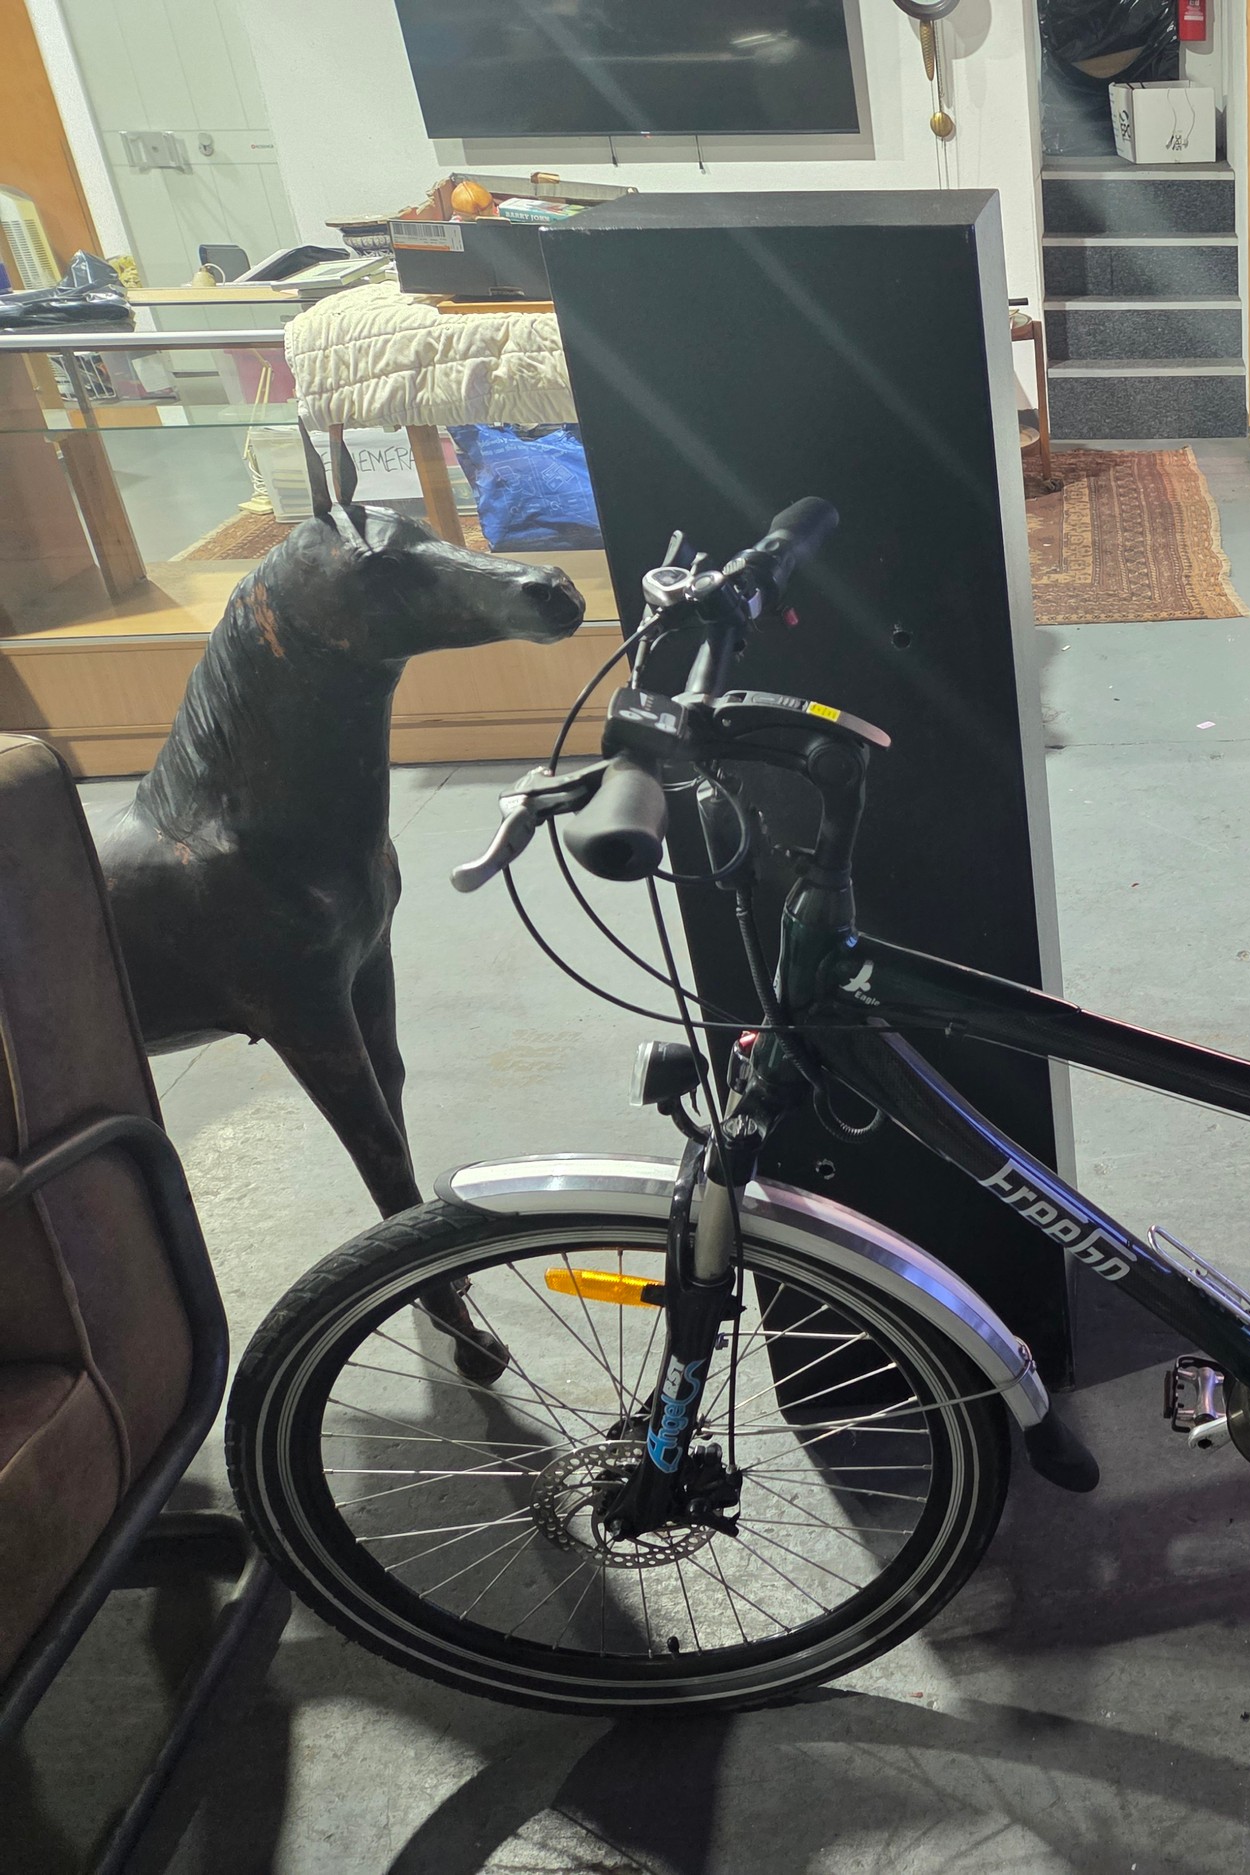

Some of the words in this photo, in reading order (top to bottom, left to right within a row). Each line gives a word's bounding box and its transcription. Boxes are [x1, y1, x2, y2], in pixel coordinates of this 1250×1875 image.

[505, 210, 529, 220] BARRY
[320, 446, 415, 473] EEMER
[854, 990, 880, 1006] Eagle
[978, 1158, 1138, 1282] FreeGo
